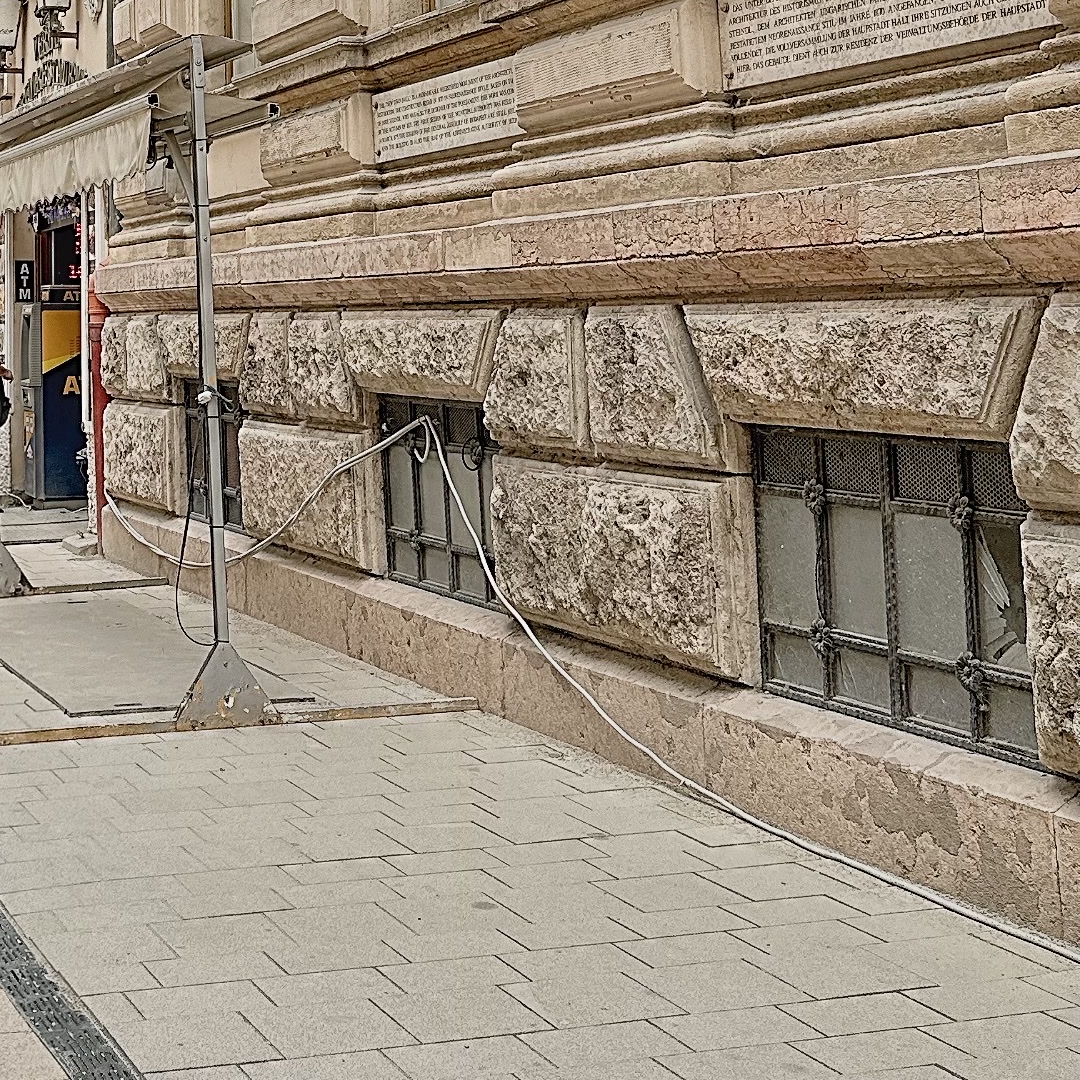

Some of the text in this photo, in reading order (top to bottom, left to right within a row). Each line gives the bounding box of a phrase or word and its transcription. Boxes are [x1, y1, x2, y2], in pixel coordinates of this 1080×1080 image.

[732, 3, 742, 12] DAS
[770, 5, 780, 15] DES
[838, 28, 849, 38] DER
[930, 0, 971, 18] SITZUNGEN
[879, 32, 893, 43] DER
[982, 10, 996, 21] DER
[1000, 0, 1046, 17] HAUPSTADT
[19, 263, 32, 300] ATM
[63, 290, 80, 301] AT
[63, 375, 80, 395] A
